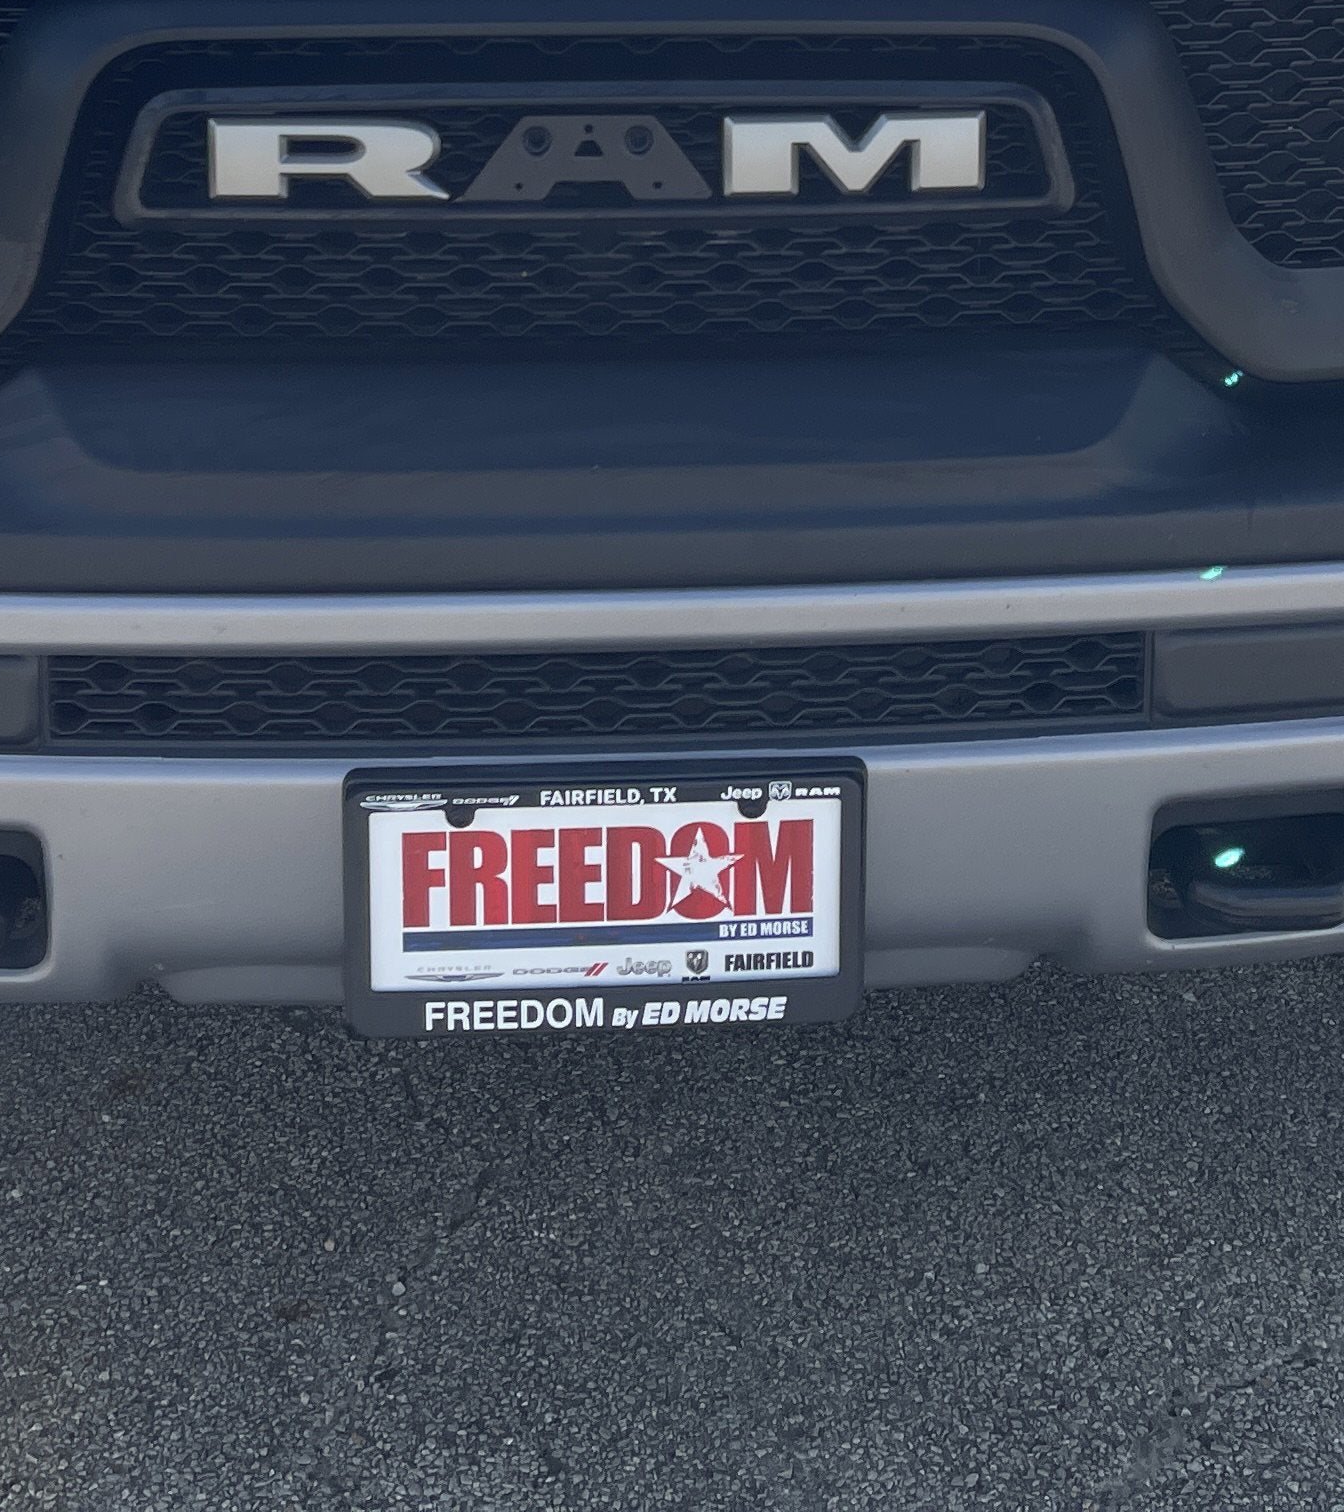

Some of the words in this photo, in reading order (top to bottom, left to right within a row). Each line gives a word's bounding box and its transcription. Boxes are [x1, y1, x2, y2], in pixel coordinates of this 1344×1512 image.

[206, 110, 987, 201] RAM
[540, 787, 645, 806] FAIRFIELD,
[650, 787, 677, 803] TX
[720, 786, 763, 800] Jeep
[794, 786, 841, 797] RAM
[402, 819, 814, 927] FREEDOM
[719, 923, 738, 937] BY
[740, 922, 757, 937] ED
[760, 920, 809, 936] MORSE
[416, 964, 493, 973] CHRYSLER
[616, 957, 673, 977] Jeep
[724, 950, 814, 972] FAIRFIELD
[425, 997, 604, 1031] FREEDOM
[611, 1007, 639, 1029] By
[642, 1001, 681, 1026] ED
[683, 996, 788, 1025] MORSE
